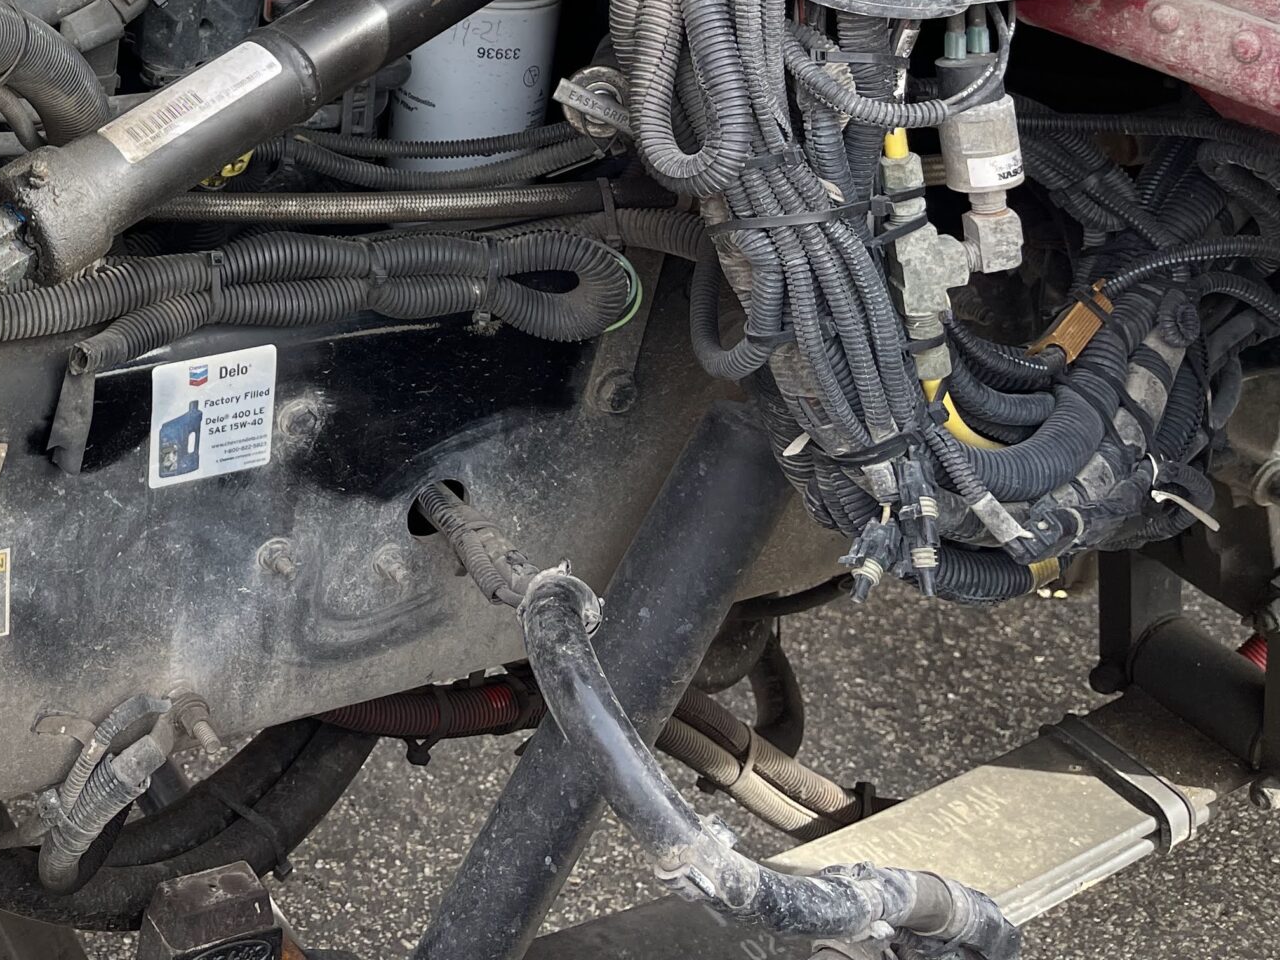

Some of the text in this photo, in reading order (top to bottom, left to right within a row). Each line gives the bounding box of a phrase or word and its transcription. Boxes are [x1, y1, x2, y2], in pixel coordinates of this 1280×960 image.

[477, 47, 520, 59] 33936
[569, 90, 629, 124] EASY-GRIP
[204, 388, 270, 408] Factory Filled
[232, 411, 251, 419] 400
[253, 407, 265, 415] LE
[208, 418, 263, 435] SAE 15W-40
